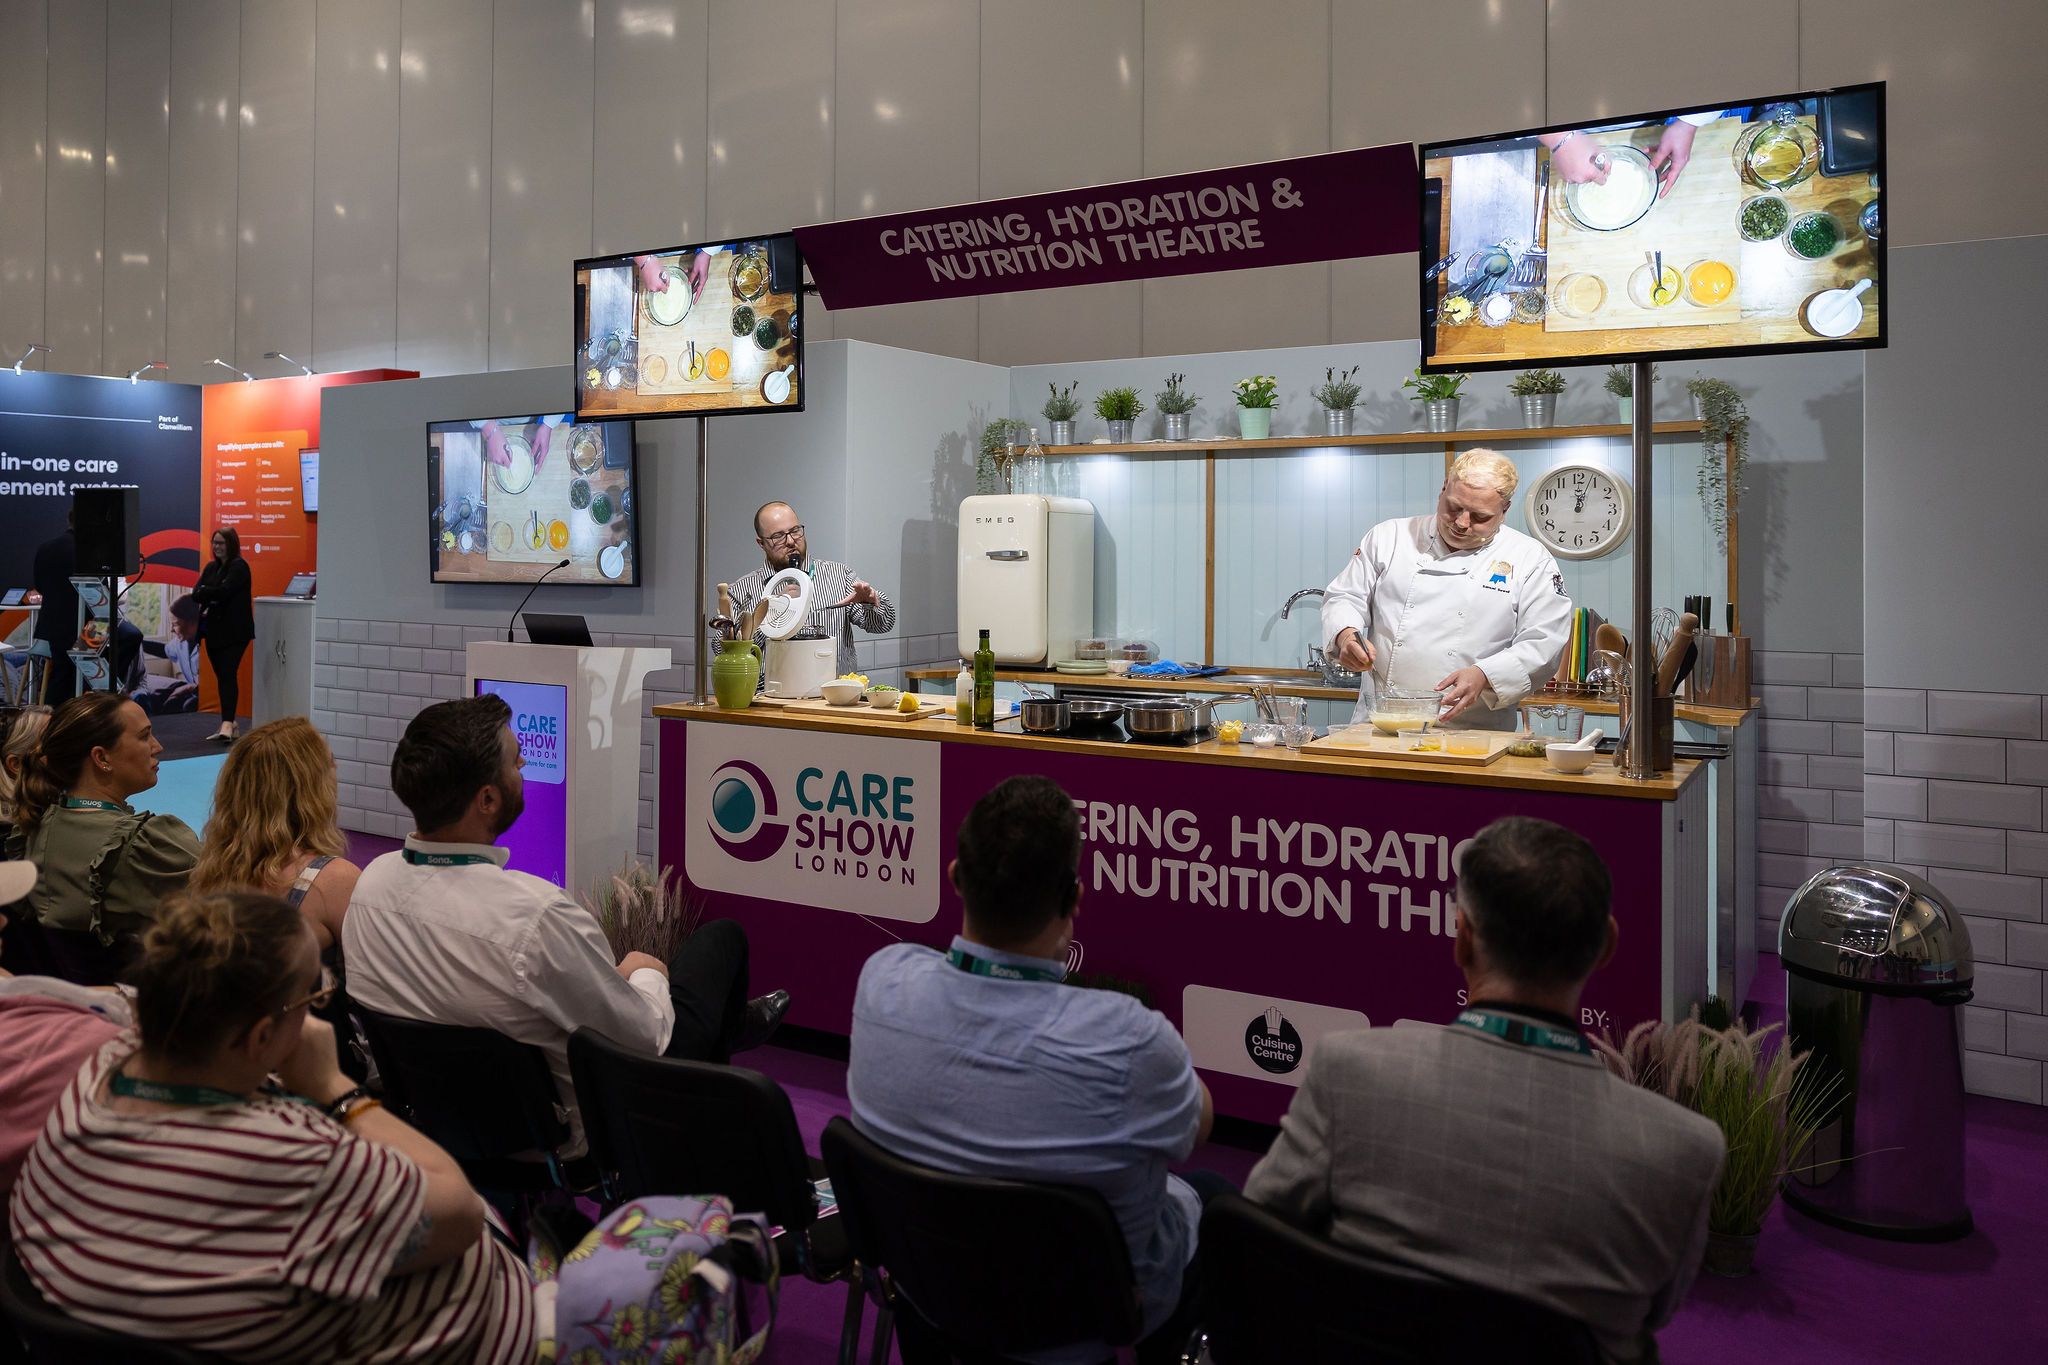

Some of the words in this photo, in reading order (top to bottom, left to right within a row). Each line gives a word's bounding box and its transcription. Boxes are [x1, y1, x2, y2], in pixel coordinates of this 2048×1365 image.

[880, 213, 1041, 256] CATERING,
[1047, 182, 1260, 237] HYDRATION
[1271, 178, 1304, 209] &
[926, 237, 1103, 283] NUTRITION
[1106, 219, 1265, 263] THEATRE
[158, 415, 172, 423] Part
[74, 459, 119, 473] care
[1557, 477, 1566, 489] 11
[1572, 472, 1585, 485] 12
[0, 480, 66, 496] ement
[1545, 488, 1557, 500] 10
[1603, 487, 1612, 500] 2
[1540, 503, 1549, 516] 9
[1607, 502, 1617, 516] 3
[975, 516, 1015, 524] SMEG
[1544, 519, 1555, 532] 8
[1602, 518, 1611, 531] 4
[1558, 530, 1566, 543] 7
[1573, 534, 1583, 547] 6
[1589, 530, 1599, 544] 5
[517, 713, 557, 735] CARE
[517, 731, 557, 751] SHOW
[522, 748, 557, 760] ONDON
[796, 767, 914, 822] CARE
[796, 813, 915, 862] SHOW
[427, 855, 453, 865] Sona.
[795, 852, 915, 886] LONDON
[1093, 850, 1351, 924] NUTRITION
[1581, 1007, 1610, 1029] BY:
[1251, 1034, 1296, 1052] Cuisine
[1253, 1045, 1294, 1062] Centre
